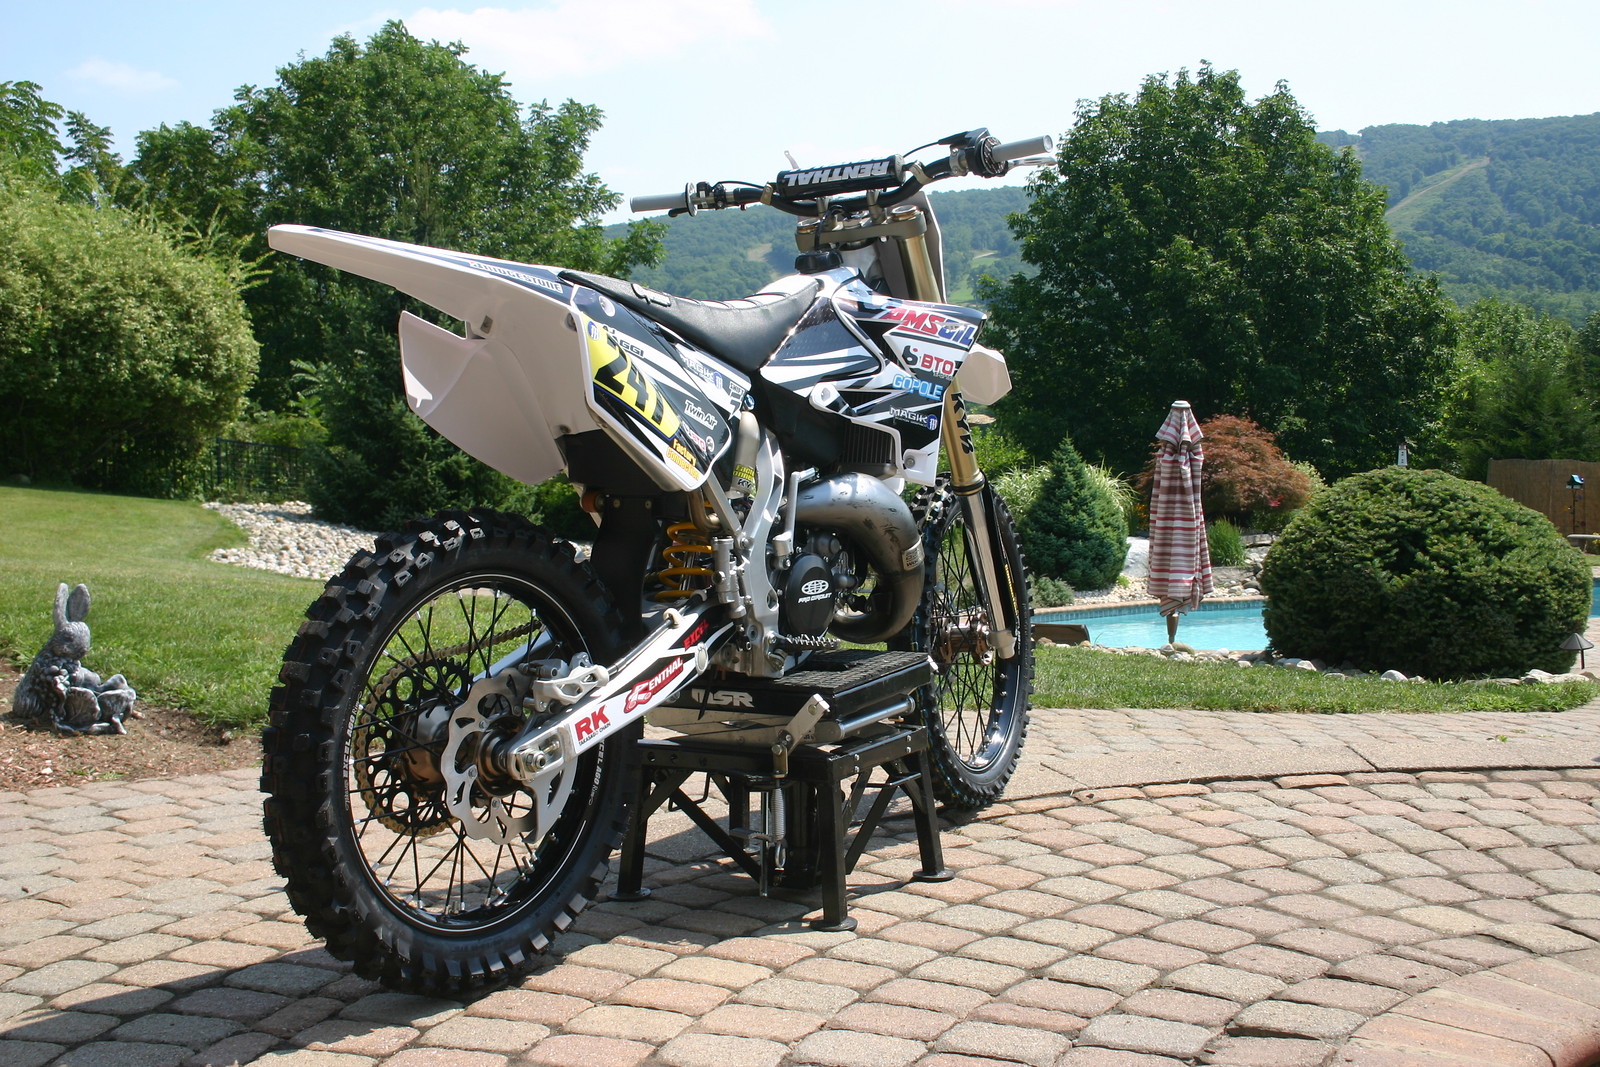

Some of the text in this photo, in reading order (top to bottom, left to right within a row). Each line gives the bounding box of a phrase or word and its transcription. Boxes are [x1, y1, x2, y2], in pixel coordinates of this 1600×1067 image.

[783, 161, 890, 187] RENTHAL
[880, 305, 975, 347] AMSOIL
[921, 353, 954, 375] BTO
[892, 374, 944, 401] GOPOLE
[890, 405, 928, 424] MAGIK
[625, 656, 684, 712] RENTHAL
[574, 704, 610, 742] RK
